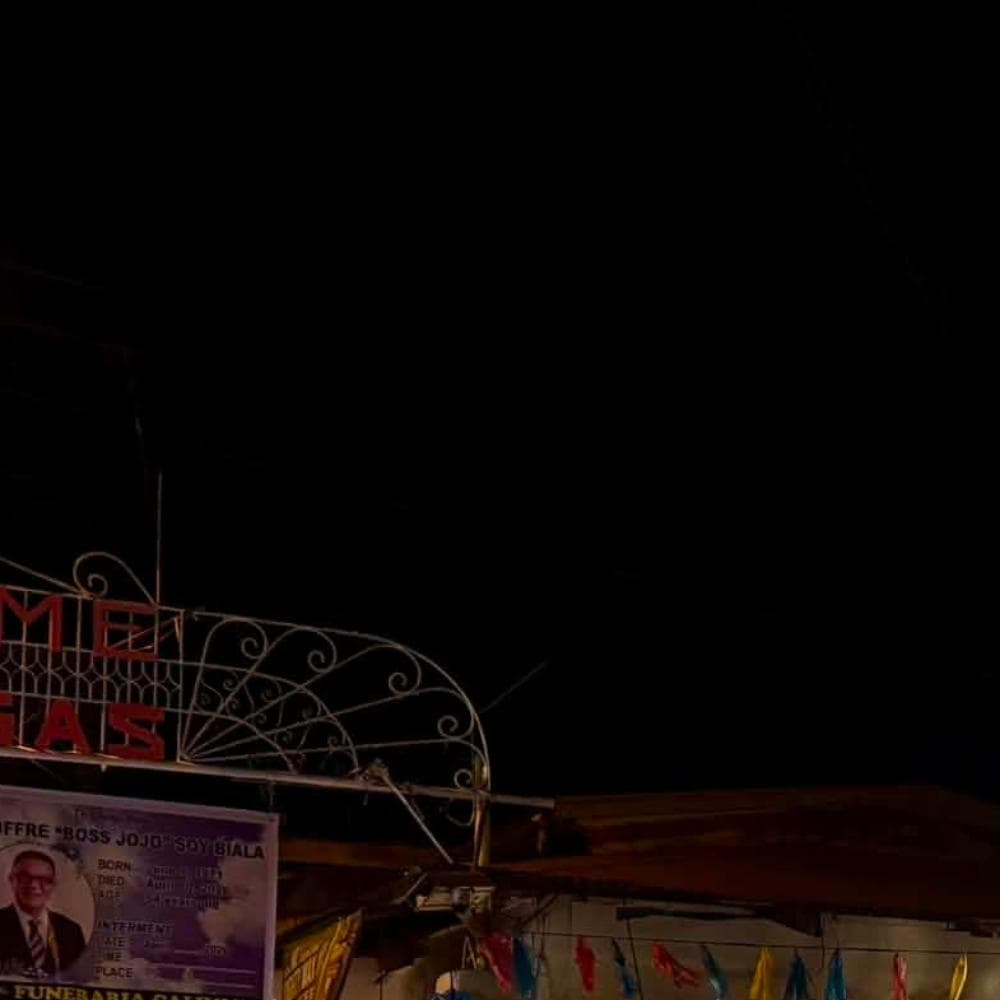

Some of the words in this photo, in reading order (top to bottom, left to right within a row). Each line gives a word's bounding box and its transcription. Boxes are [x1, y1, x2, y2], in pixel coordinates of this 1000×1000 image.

[0, 821, 50, 838] FFRE
[175, 836, 208, 853] SOY
[214, 841, 265, 859] BIALA
[95, 966, 134, 979] PLACE
